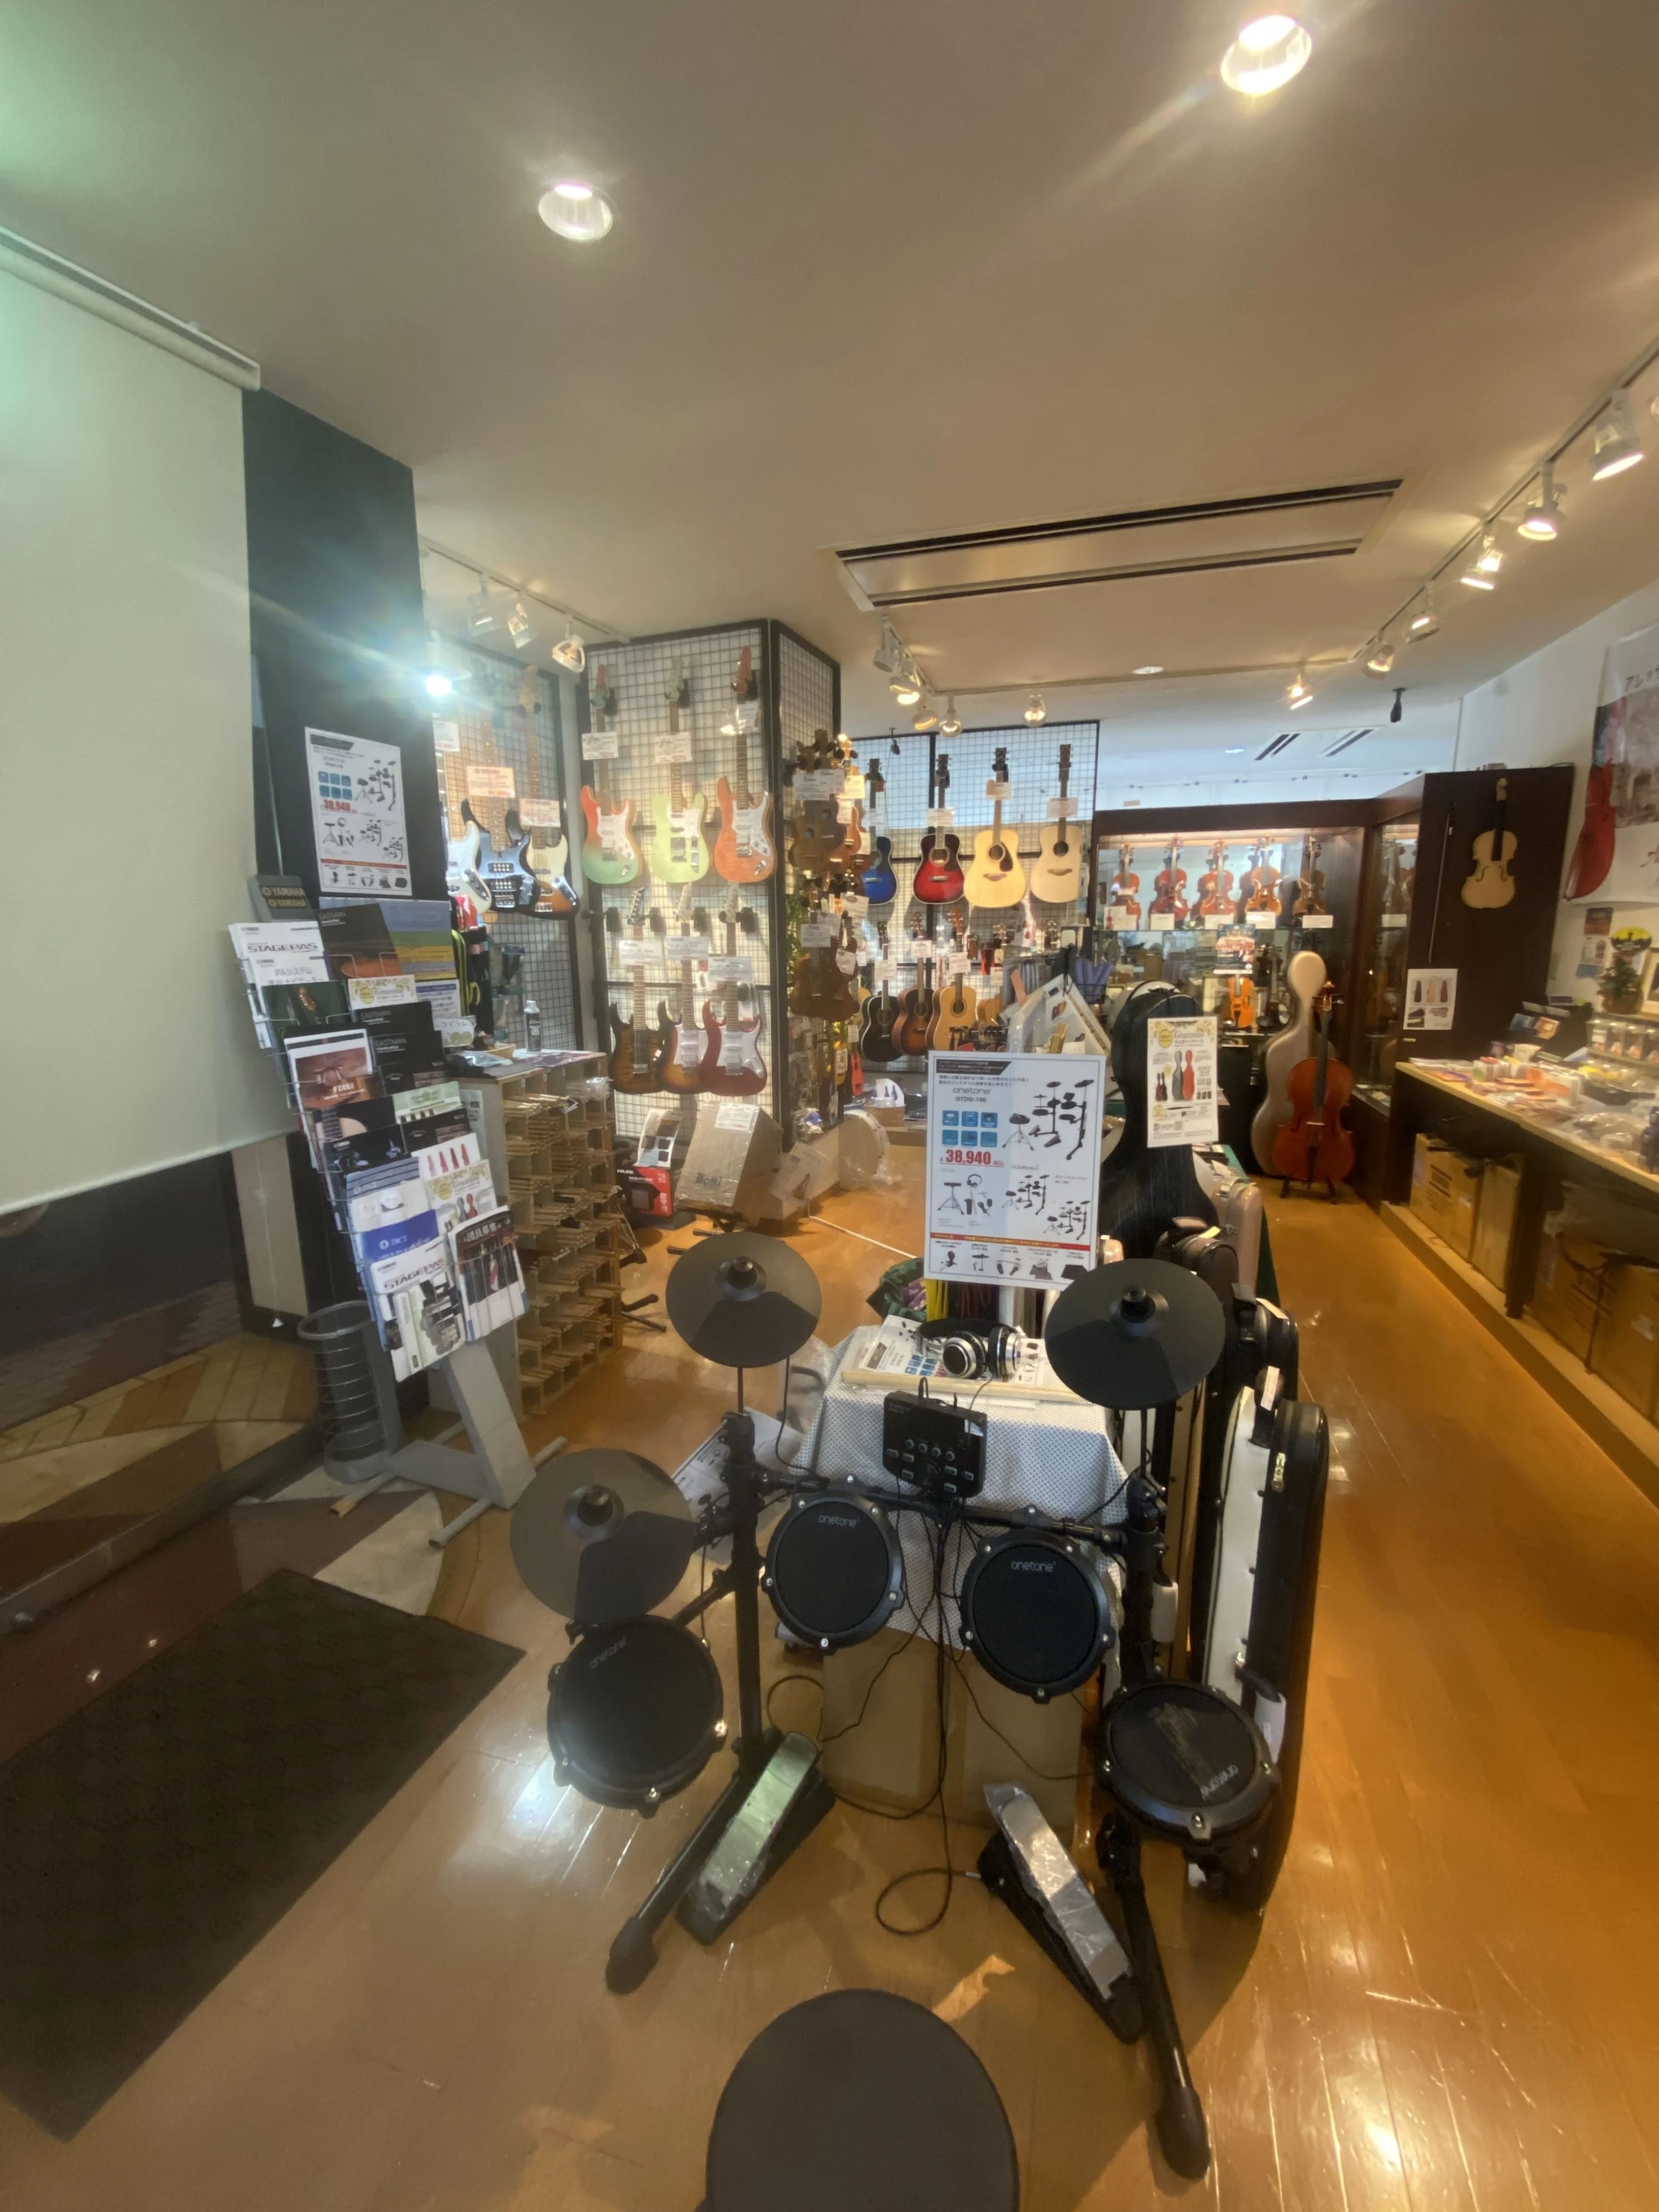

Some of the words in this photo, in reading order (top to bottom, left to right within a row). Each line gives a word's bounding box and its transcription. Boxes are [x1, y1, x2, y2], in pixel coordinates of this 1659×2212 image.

[270, 886, 306, 896] YAMAHA
[247, 942, 318, 953] STAGEPAS
[946, 1150, 992, 1165] 38,940
[383, 1258, 444, 1291] STAGEPAS
[818, 1515, 857, 1528] onetone
[1010, 1561, 1053, 1572] onetone
[588, 1639, 627, 1669] onetone
[1199, 1764, 1239, 1797] onetone
